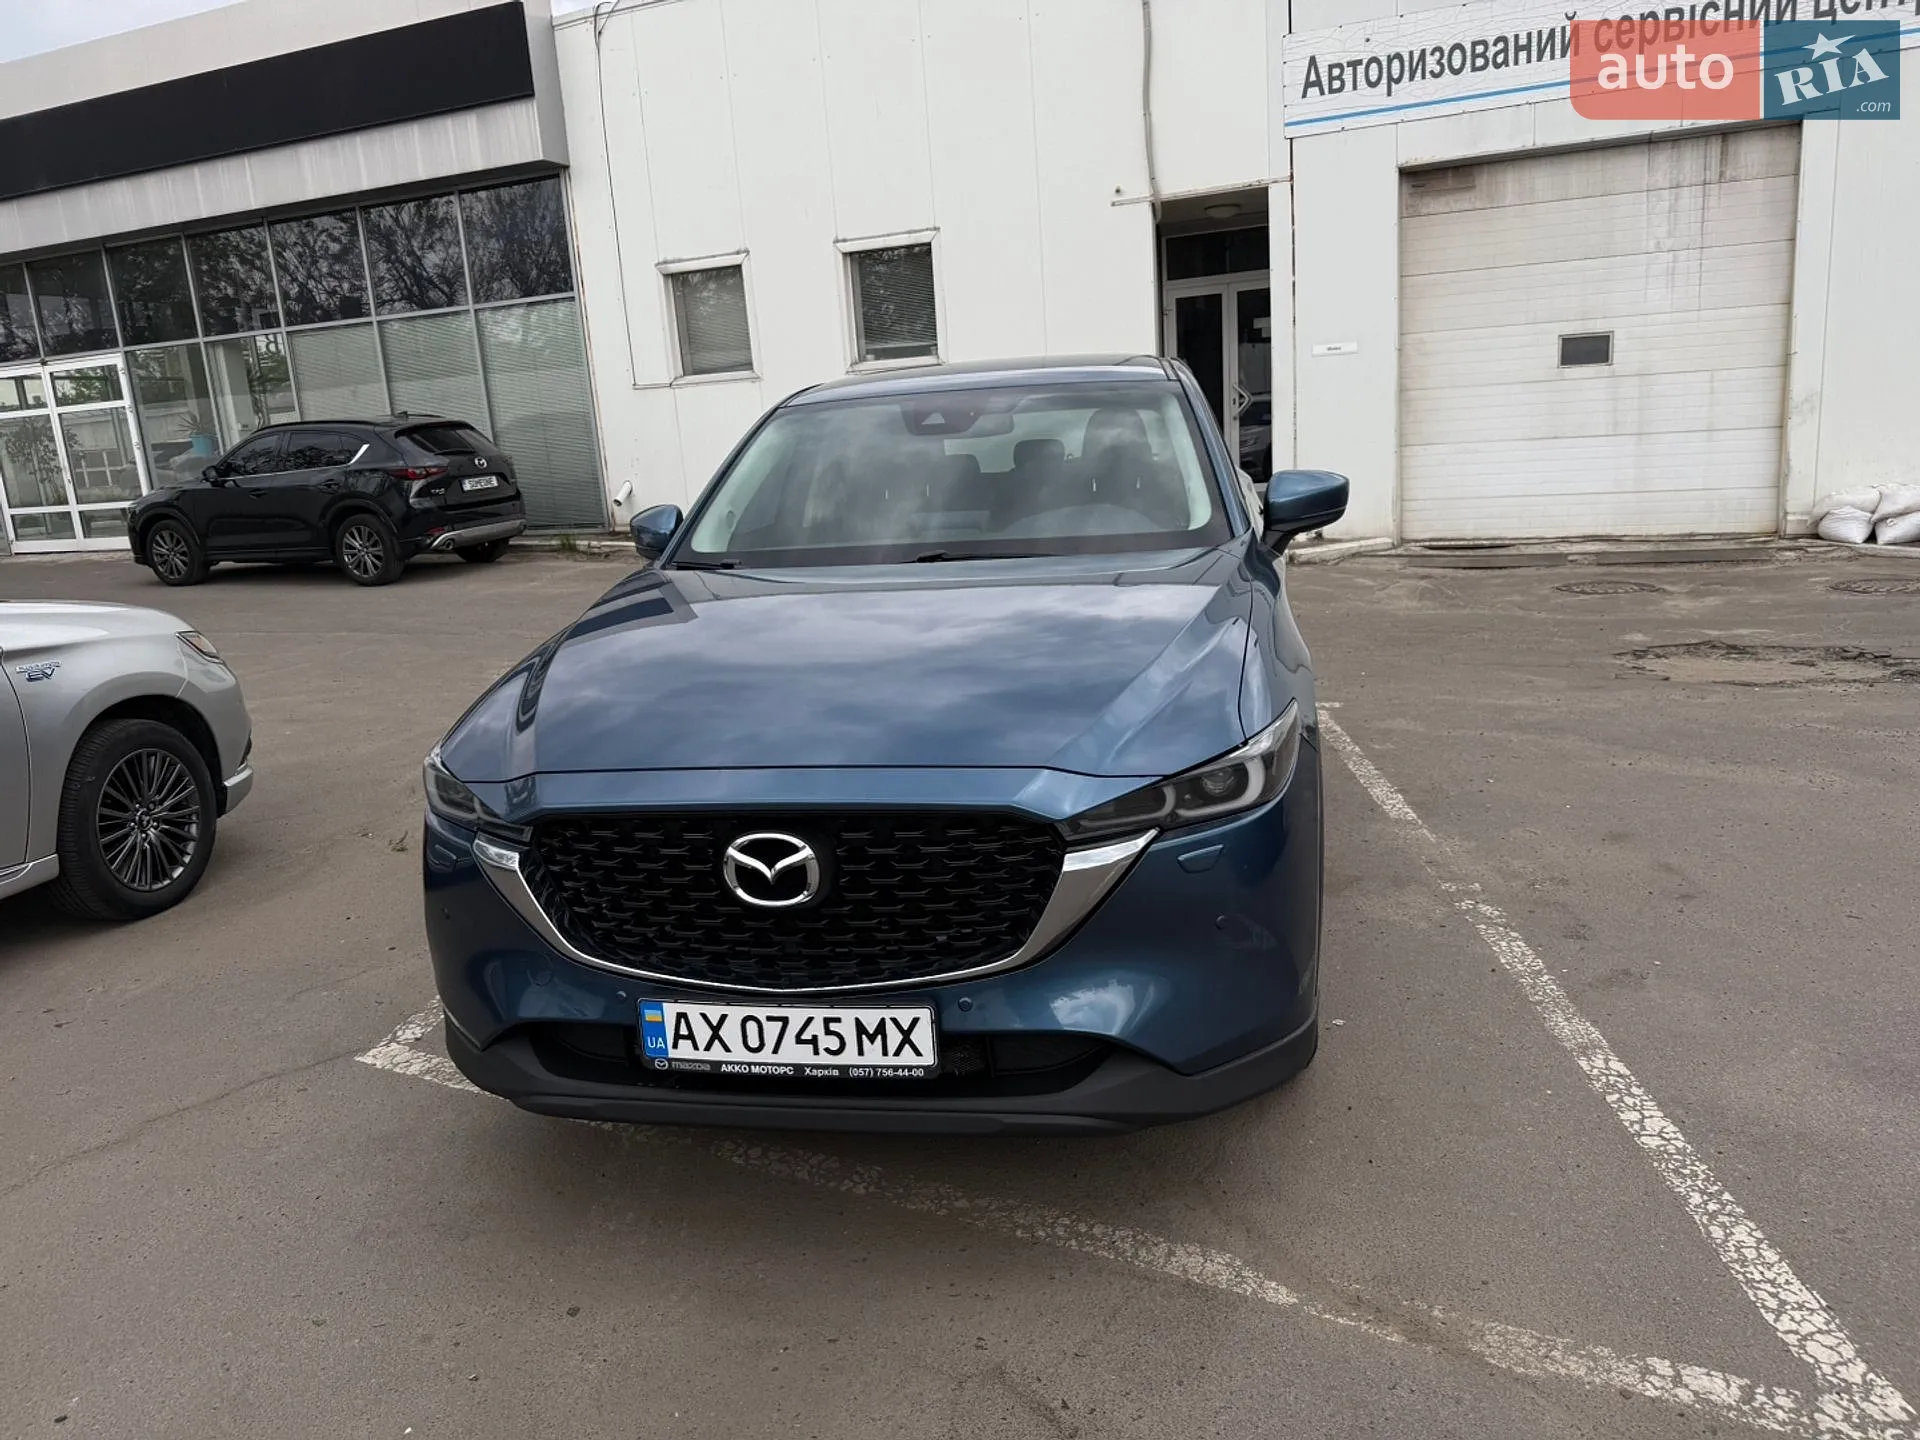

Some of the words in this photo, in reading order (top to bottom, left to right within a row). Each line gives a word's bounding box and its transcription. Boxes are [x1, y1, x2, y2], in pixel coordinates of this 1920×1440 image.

[1301, 10, 1580, 98] Авторизований
[647, 1036, 665, 1049] UA
[671, 1012, 733, 1053] AX
[740, 1015, 846, 1056] 0745
[854, 1016, 923, 1057] MX
[849, 1067, 874, 1077] (057)
